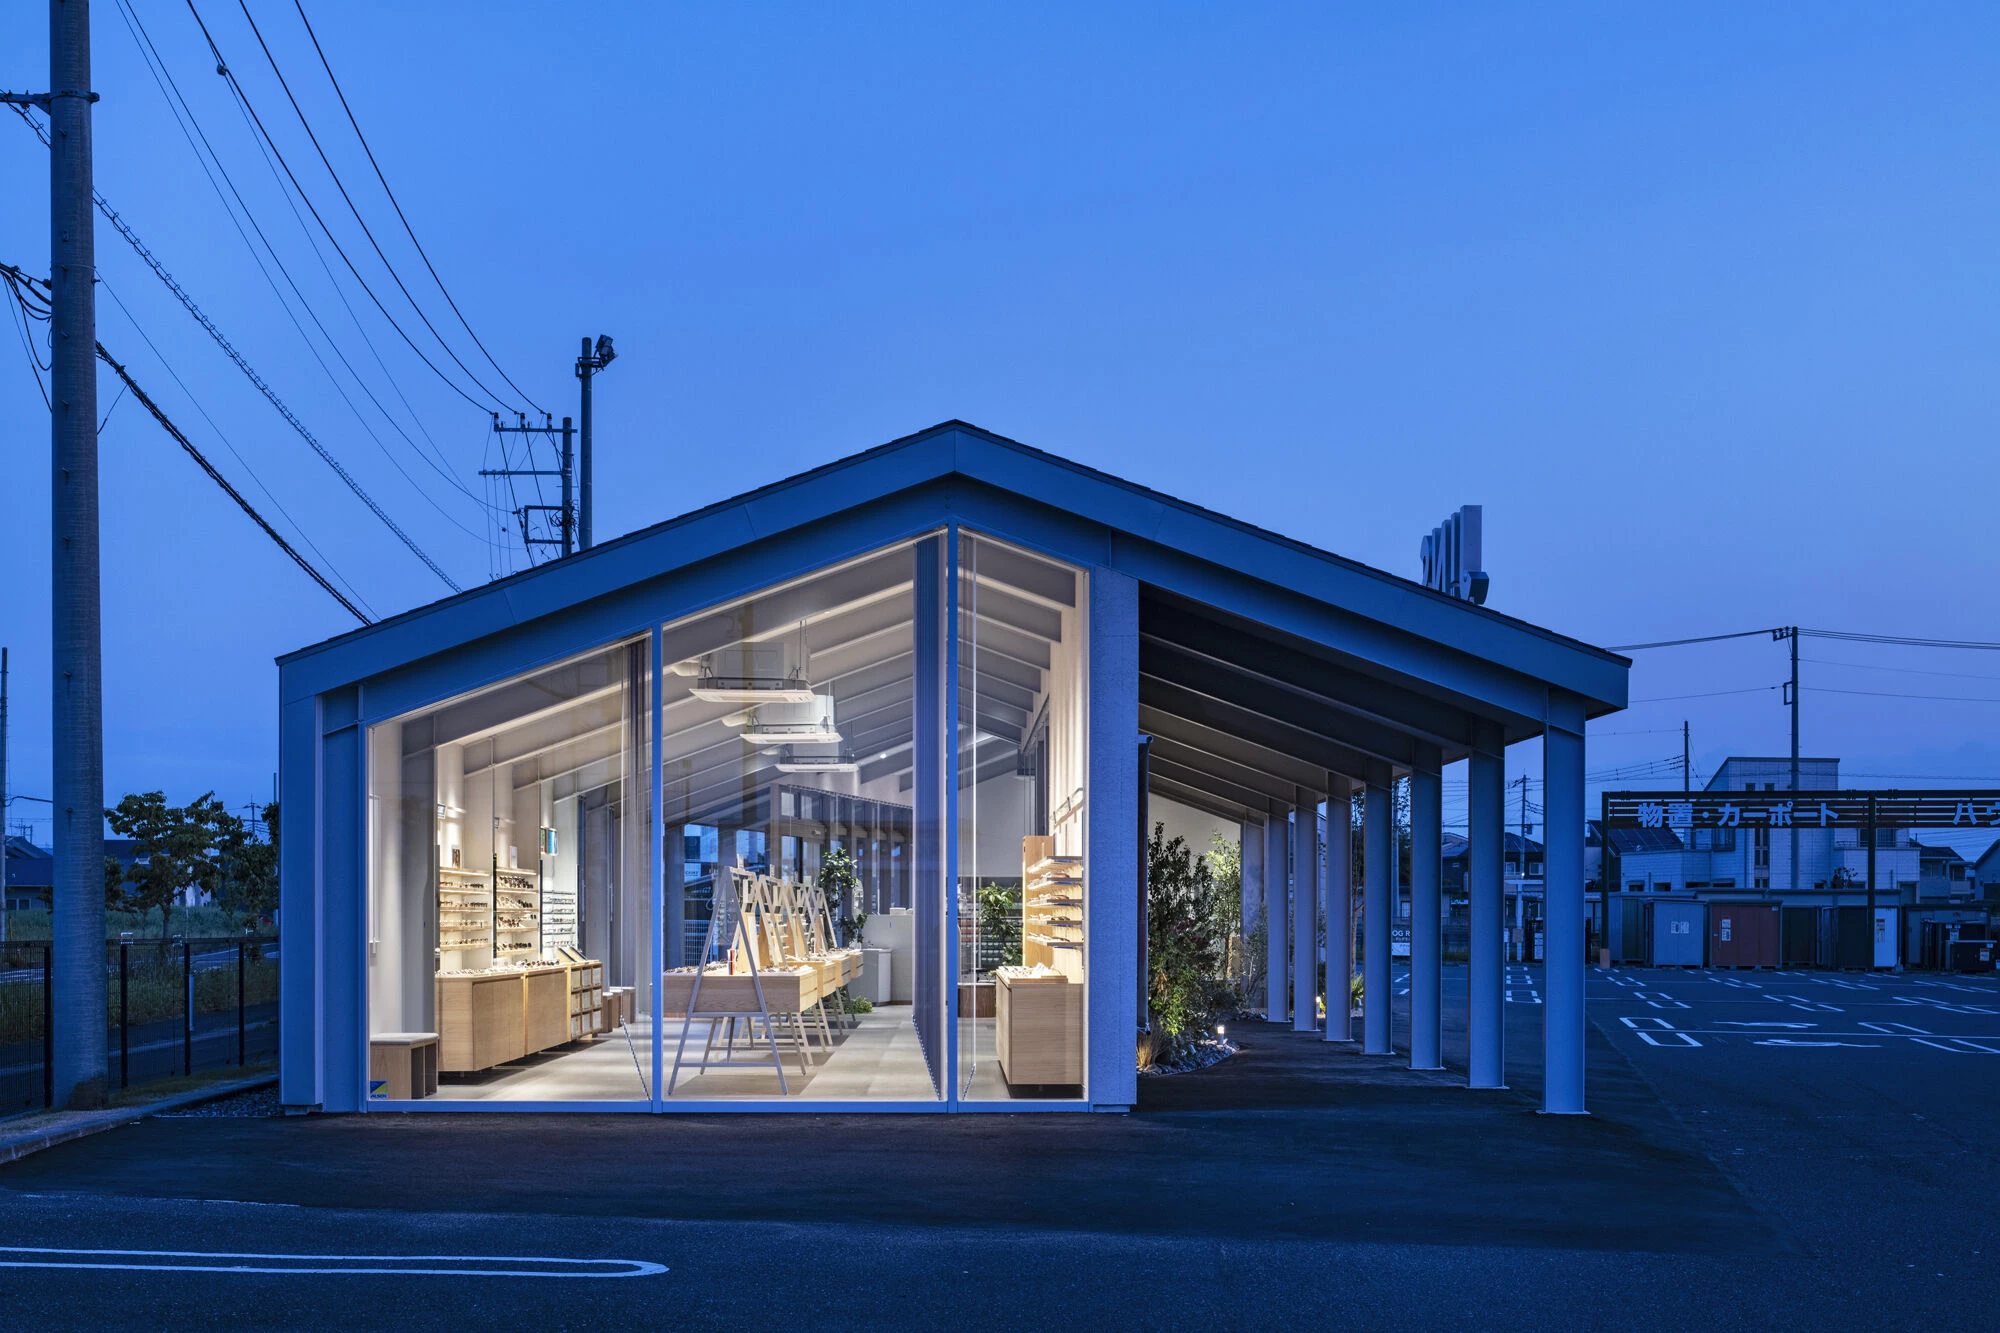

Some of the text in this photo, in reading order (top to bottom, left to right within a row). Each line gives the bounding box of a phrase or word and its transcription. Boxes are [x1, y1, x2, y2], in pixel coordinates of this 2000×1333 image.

[1637, 801, 1839, 828] 物置・カーポート
